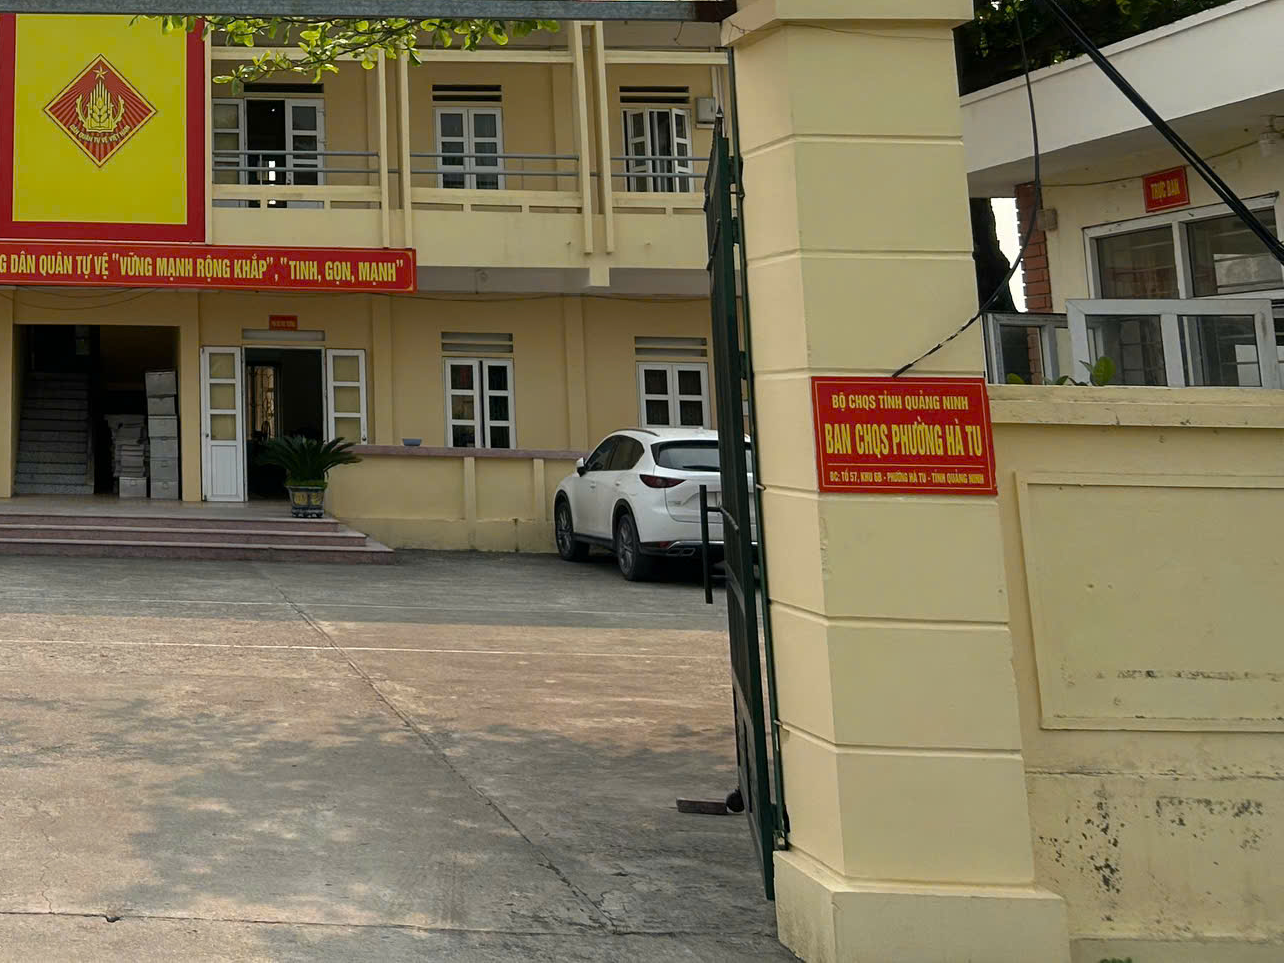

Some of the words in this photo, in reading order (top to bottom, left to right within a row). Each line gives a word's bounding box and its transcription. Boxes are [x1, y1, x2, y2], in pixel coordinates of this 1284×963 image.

[10, 250, 36, 274] DÂN
[39, 251, 73, 276] QUÂN
[76, 254, 93, 279] TỰ
[93, 252, 109, 280] VỆ
[156, 257, 193, 282] MẠNH
[196, 255, 231, 283] RỘNG
[325, 261, 355, 285] GỌN,
[832, 392, 846, 412] BỘ
[848, 394, 876, 410] CHQS
[878, 390, 902, 409] TỈNH
[905, 390, 940, 410] QUẢNG
[942, 395, 969, 410] NINH
[825, 423, 852, 454] BAN
[855, 423, 890, 458] CHQS
[892, 416, 944, 456] PHƯỜNG
[945, 418, 964, 456] HÀ
[965, 425, 983, 456] TU
[918, 472, 926, 483] TU
